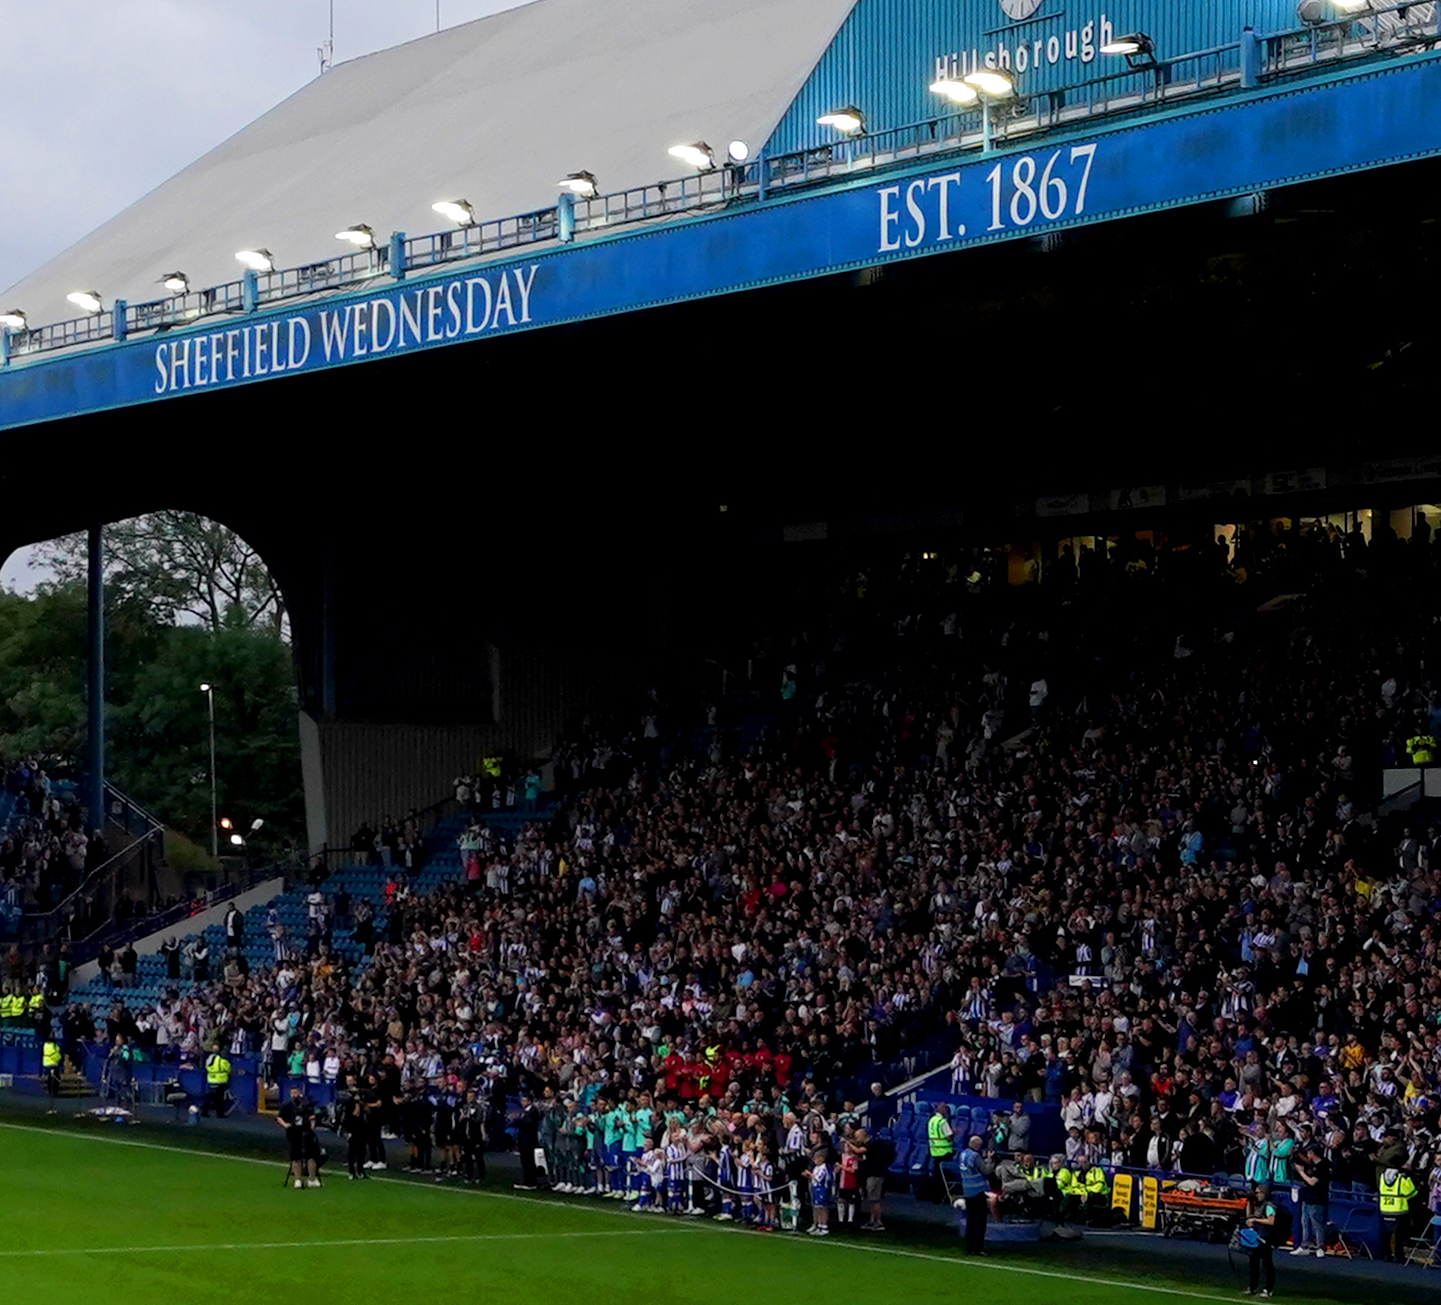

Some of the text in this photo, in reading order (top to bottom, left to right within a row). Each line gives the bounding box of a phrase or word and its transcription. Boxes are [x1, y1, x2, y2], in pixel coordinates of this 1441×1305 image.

[935, 14, 1114, 79] Hillsborough
[876, 143, 1098, 253] EST. 1867
[154, 264, 540, 394] SHEFFIELD WEDNESDAY
